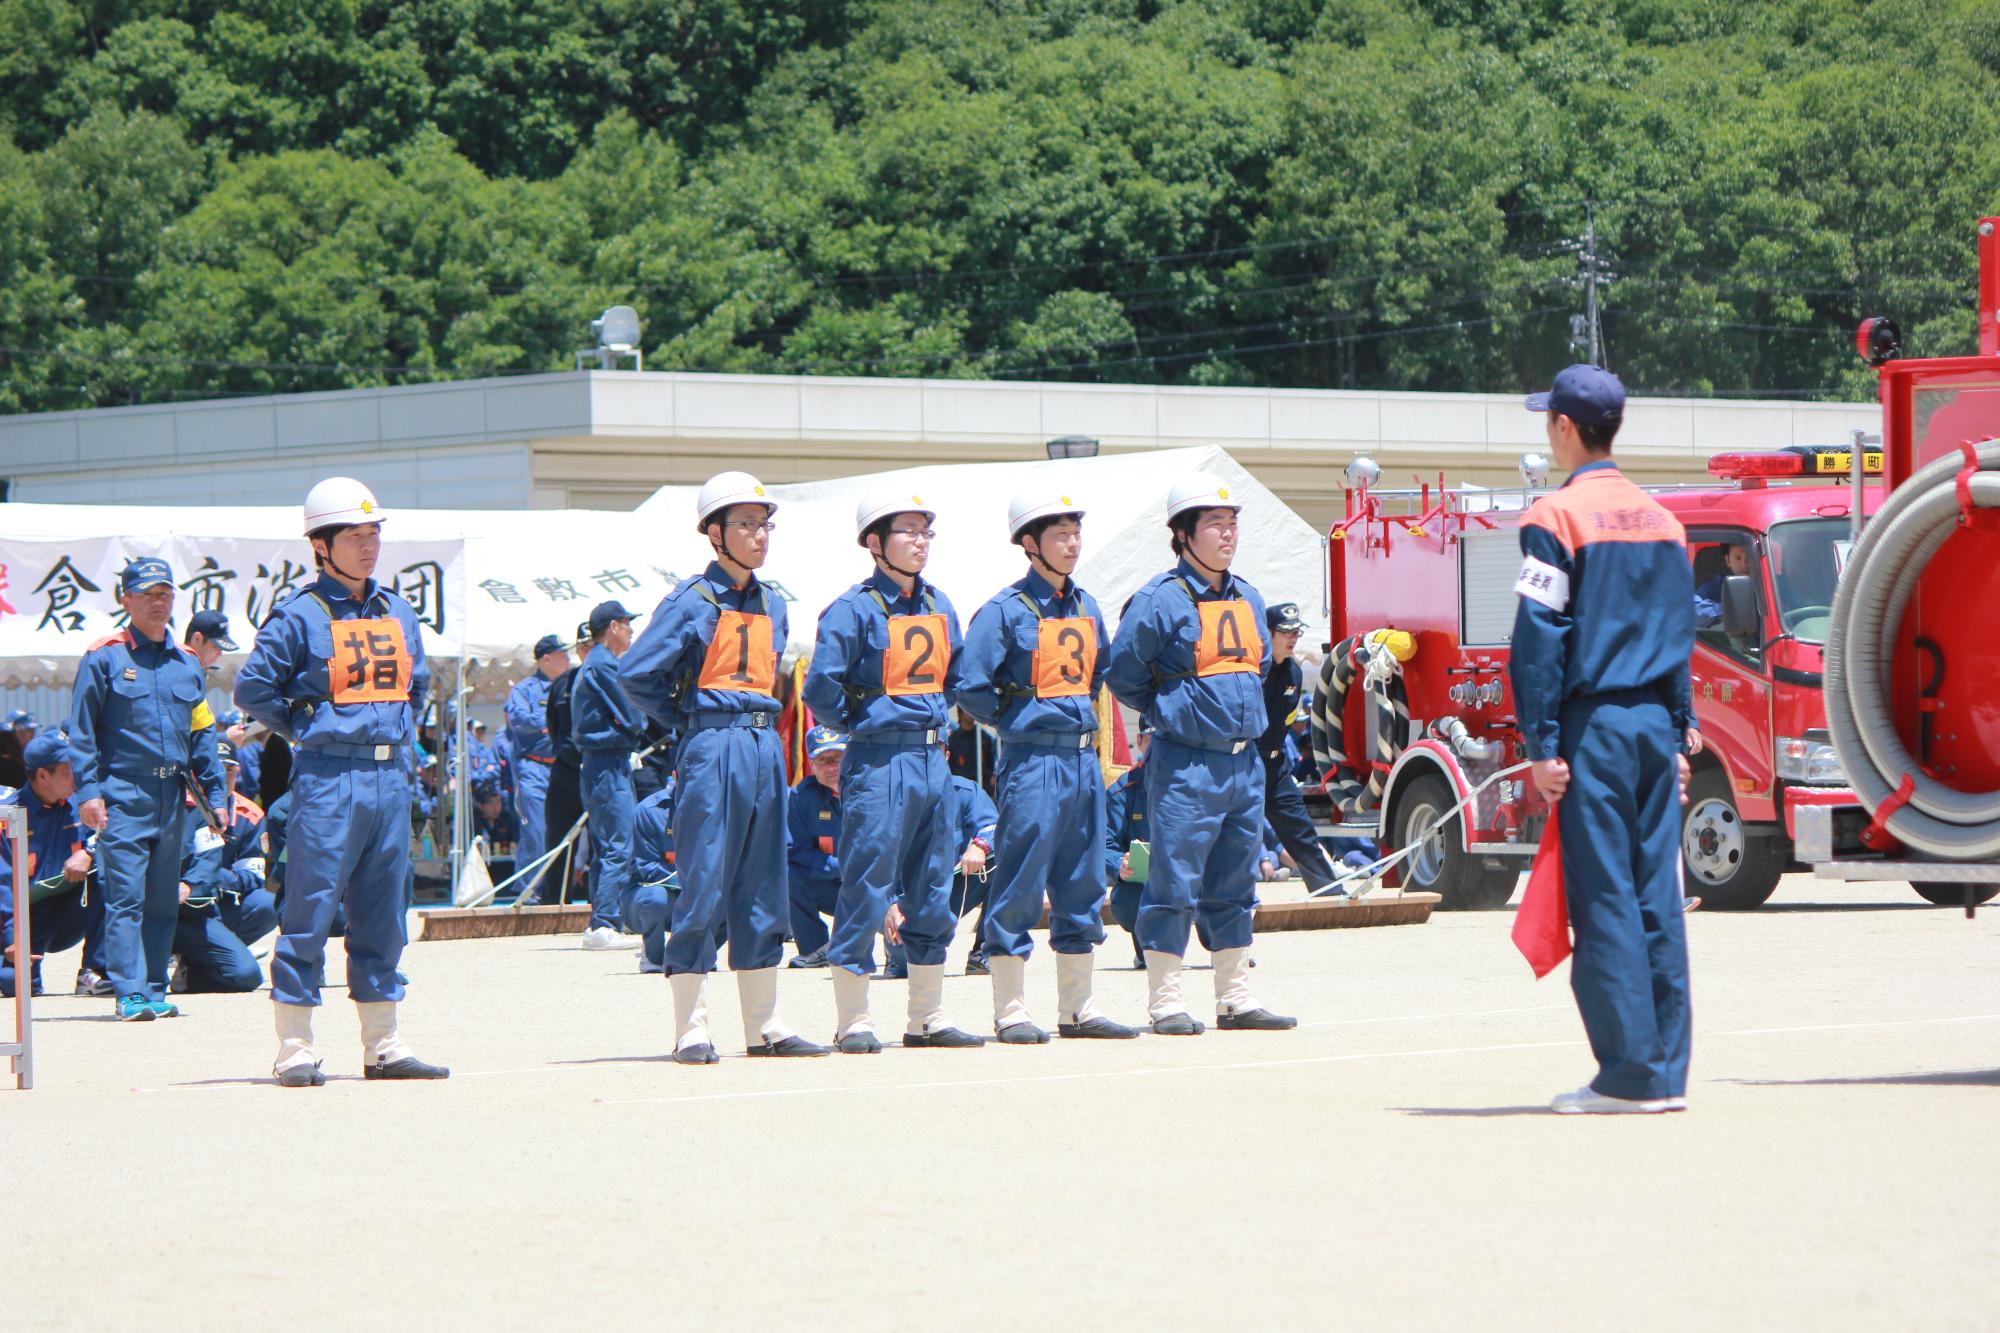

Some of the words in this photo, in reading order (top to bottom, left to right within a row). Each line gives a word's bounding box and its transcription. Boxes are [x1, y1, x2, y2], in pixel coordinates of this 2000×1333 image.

[31, 555, 445, 635] 倉市消団
[478, 564, 798, 603] 倉敷市
[344, 630, 397, 690] 指
[730, 624, 753, 683] 1
[904, 625, 934, 684] 2
[1058, 627, 1085, 684] 3
[1217, 610, 1248, 662] 4
